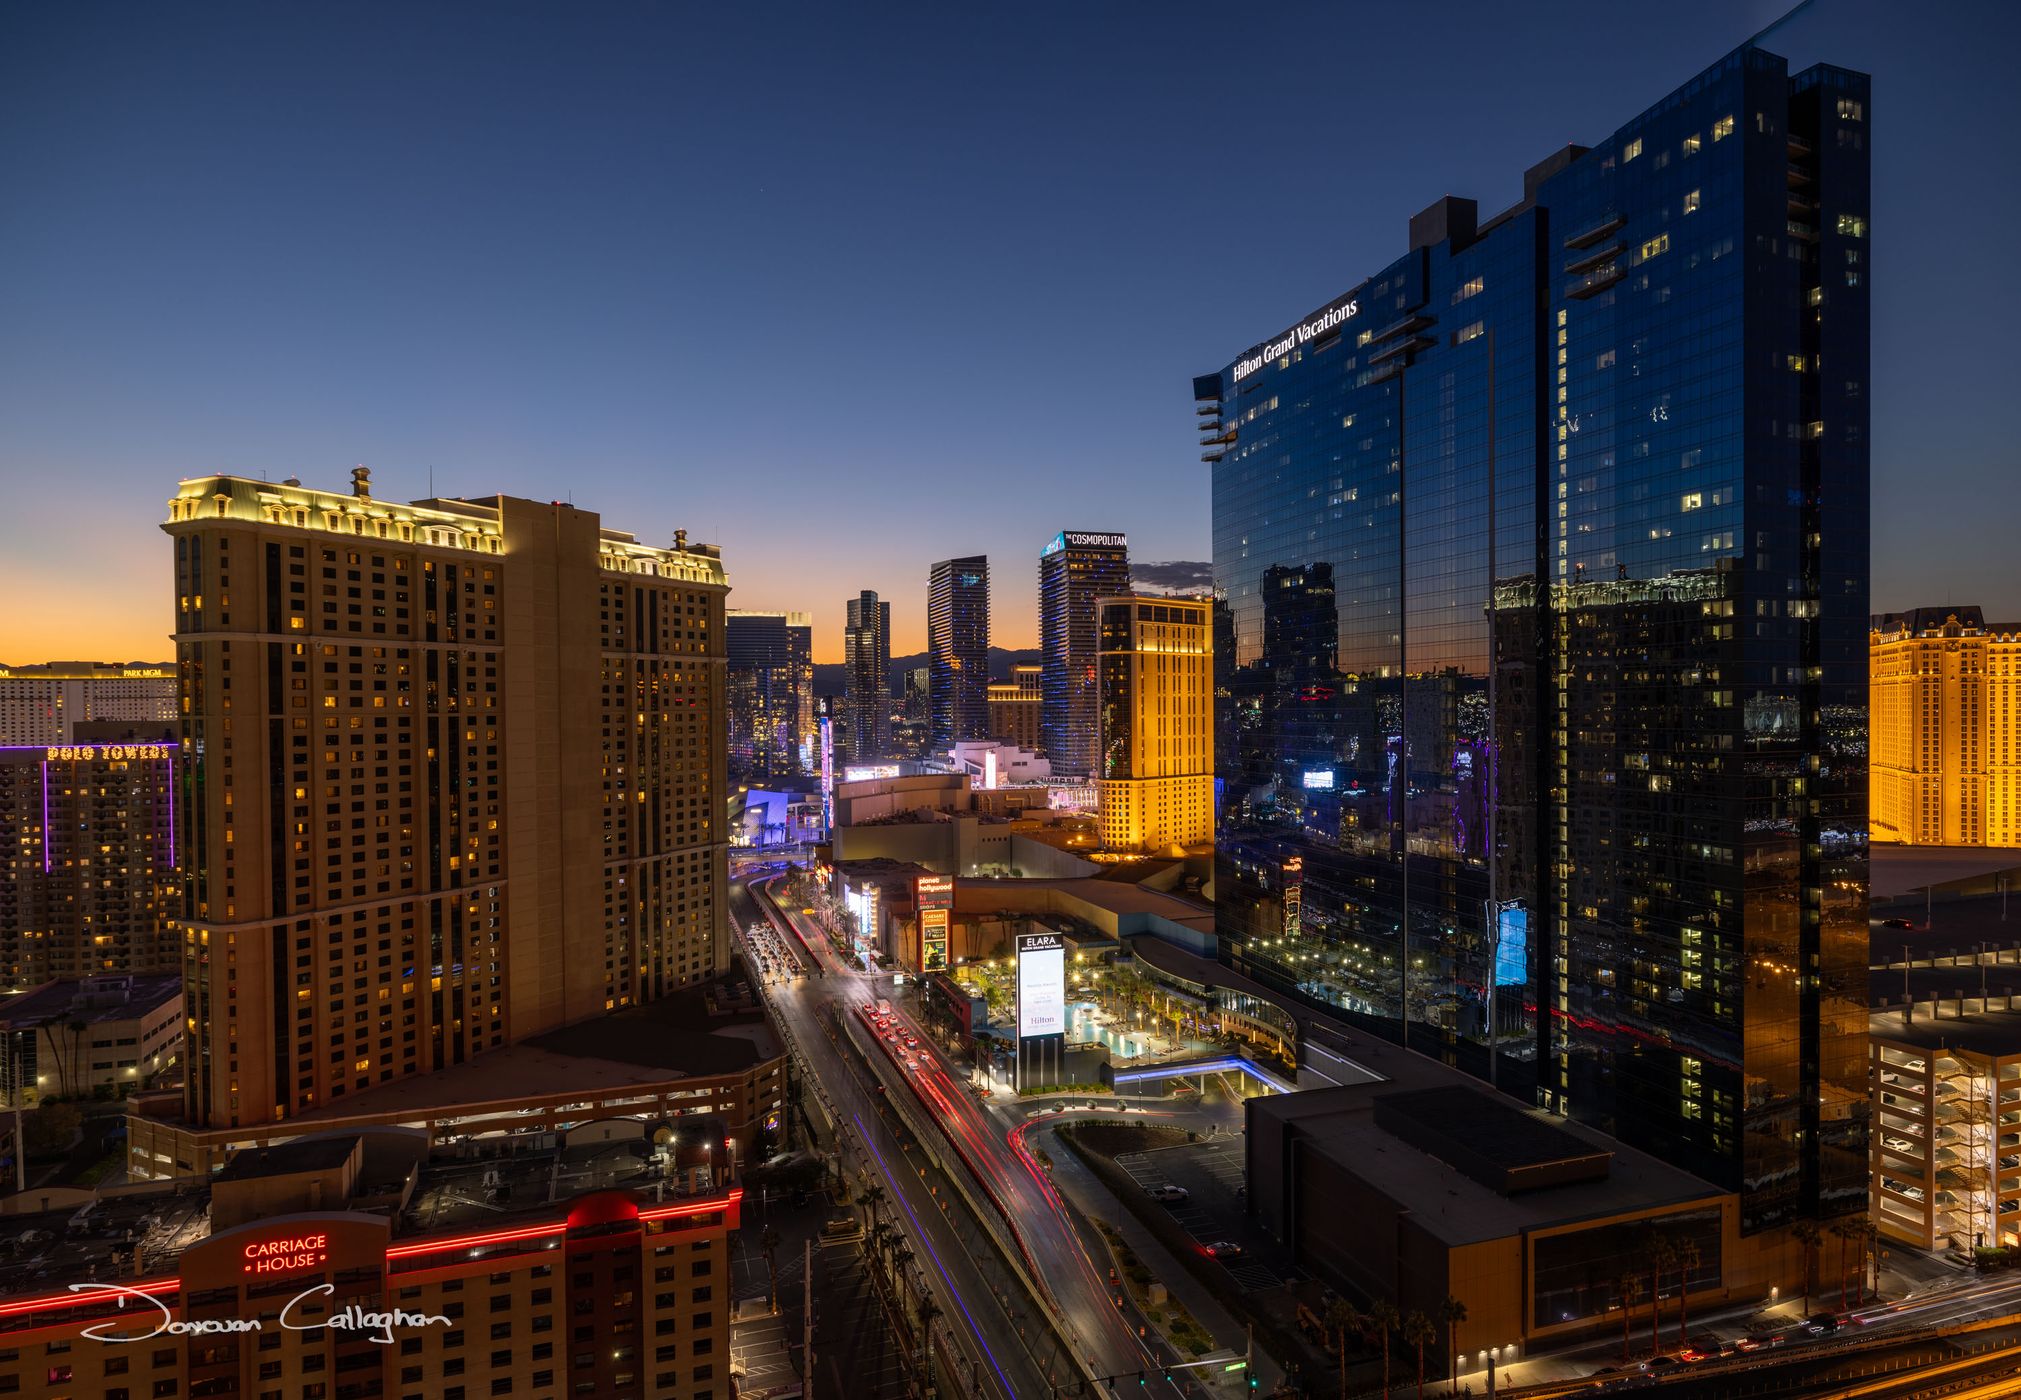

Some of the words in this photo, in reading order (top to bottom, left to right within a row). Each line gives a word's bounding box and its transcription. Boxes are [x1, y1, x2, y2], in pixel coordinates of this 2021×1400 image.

[1233, 355, 1262, 383] Hilton
[1264, 331, 1295, 363] Grand
[1297, 300, 1357, 343] Vacations
[1072, 534, 1127, 546] COSMOPOLITAN
[123, 669, 142, 677] PARK
[142, 669, 161, 677] MGM
[47, 746, 95, 761] POLO
[101, 745, 169, 760] TOWERS
[918, 876, 940, 885] planet
[918, 882, 952, 893] hollywood
[1026, 936, 1056, 947] ELARA
[1031, 1016, 1055, 1025] Hilton
[245, 1235, 326, 1258] CARRIAGE
[257, 1253, 315, 1273] HOUSE
